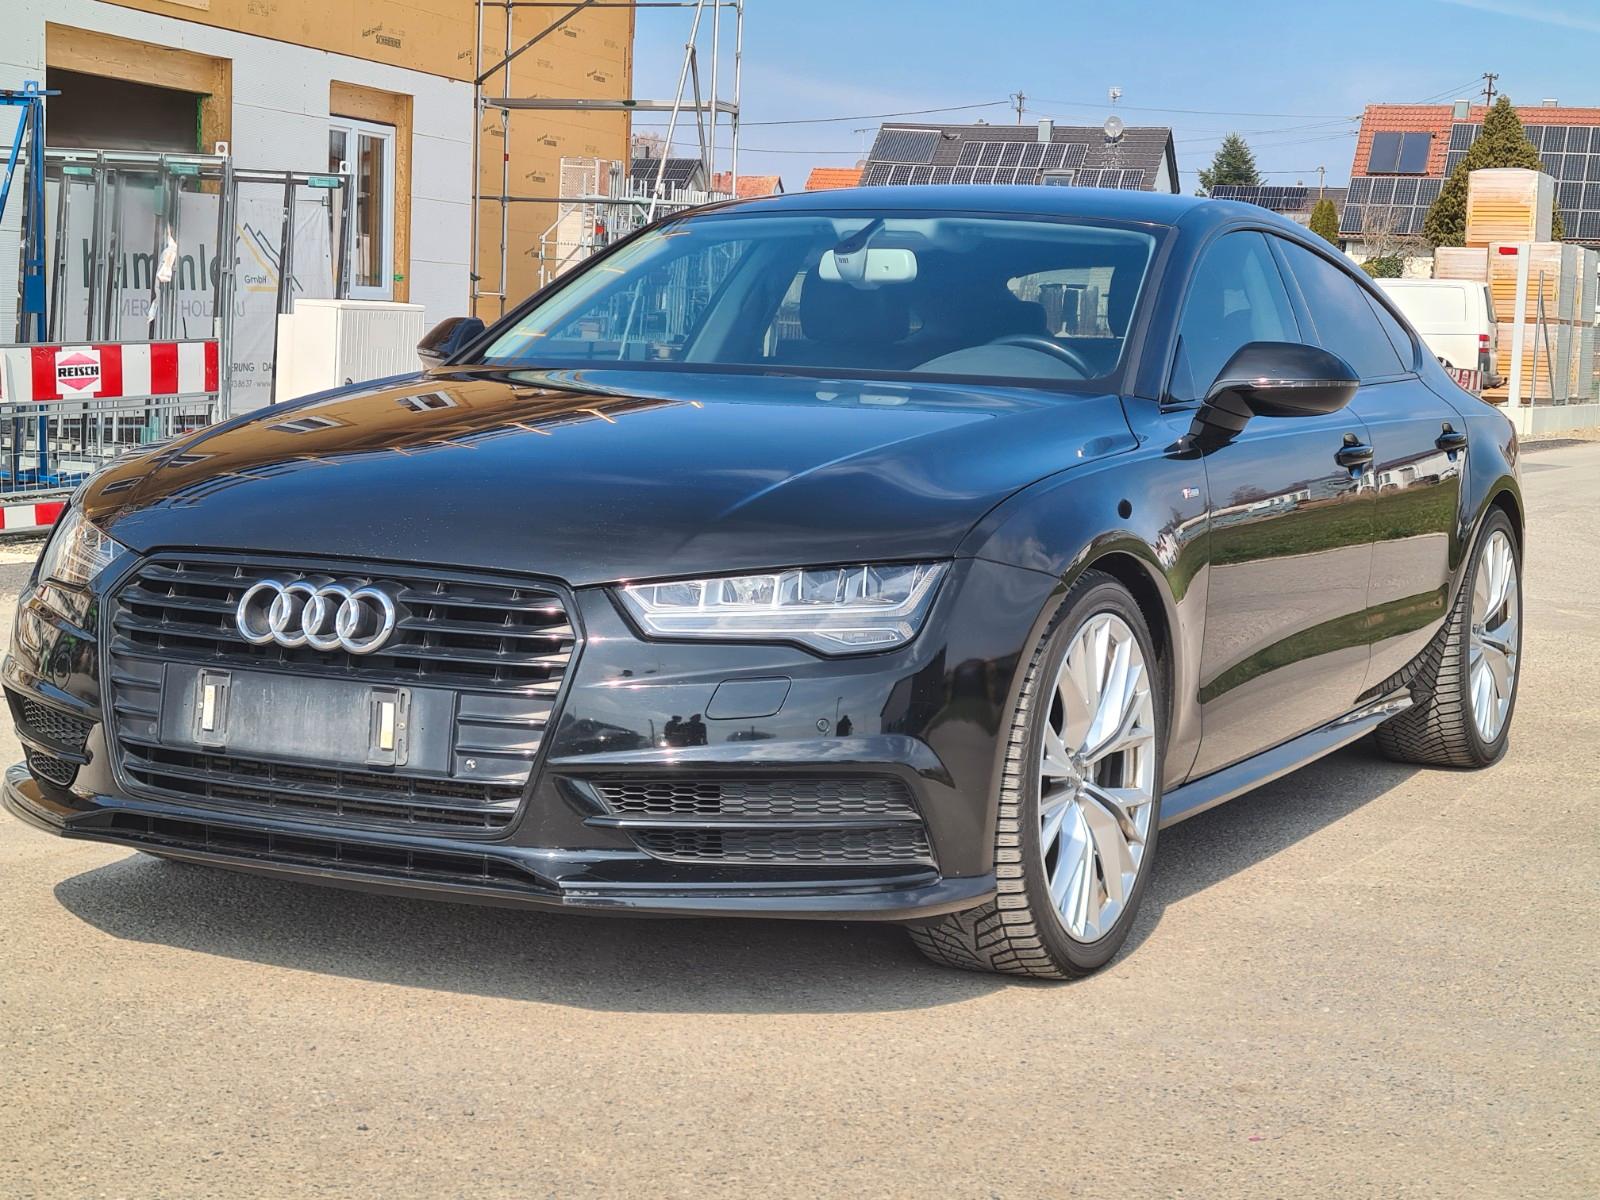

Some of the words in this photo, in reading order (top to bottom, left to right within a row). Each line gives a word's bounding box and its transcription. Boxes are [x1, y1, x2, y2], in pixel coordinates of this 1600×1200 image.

[244, 275, 267, 284] GmbH
[181, 300, 245, 317] HOLZU
[57, 366, 99, 377] REISCH
